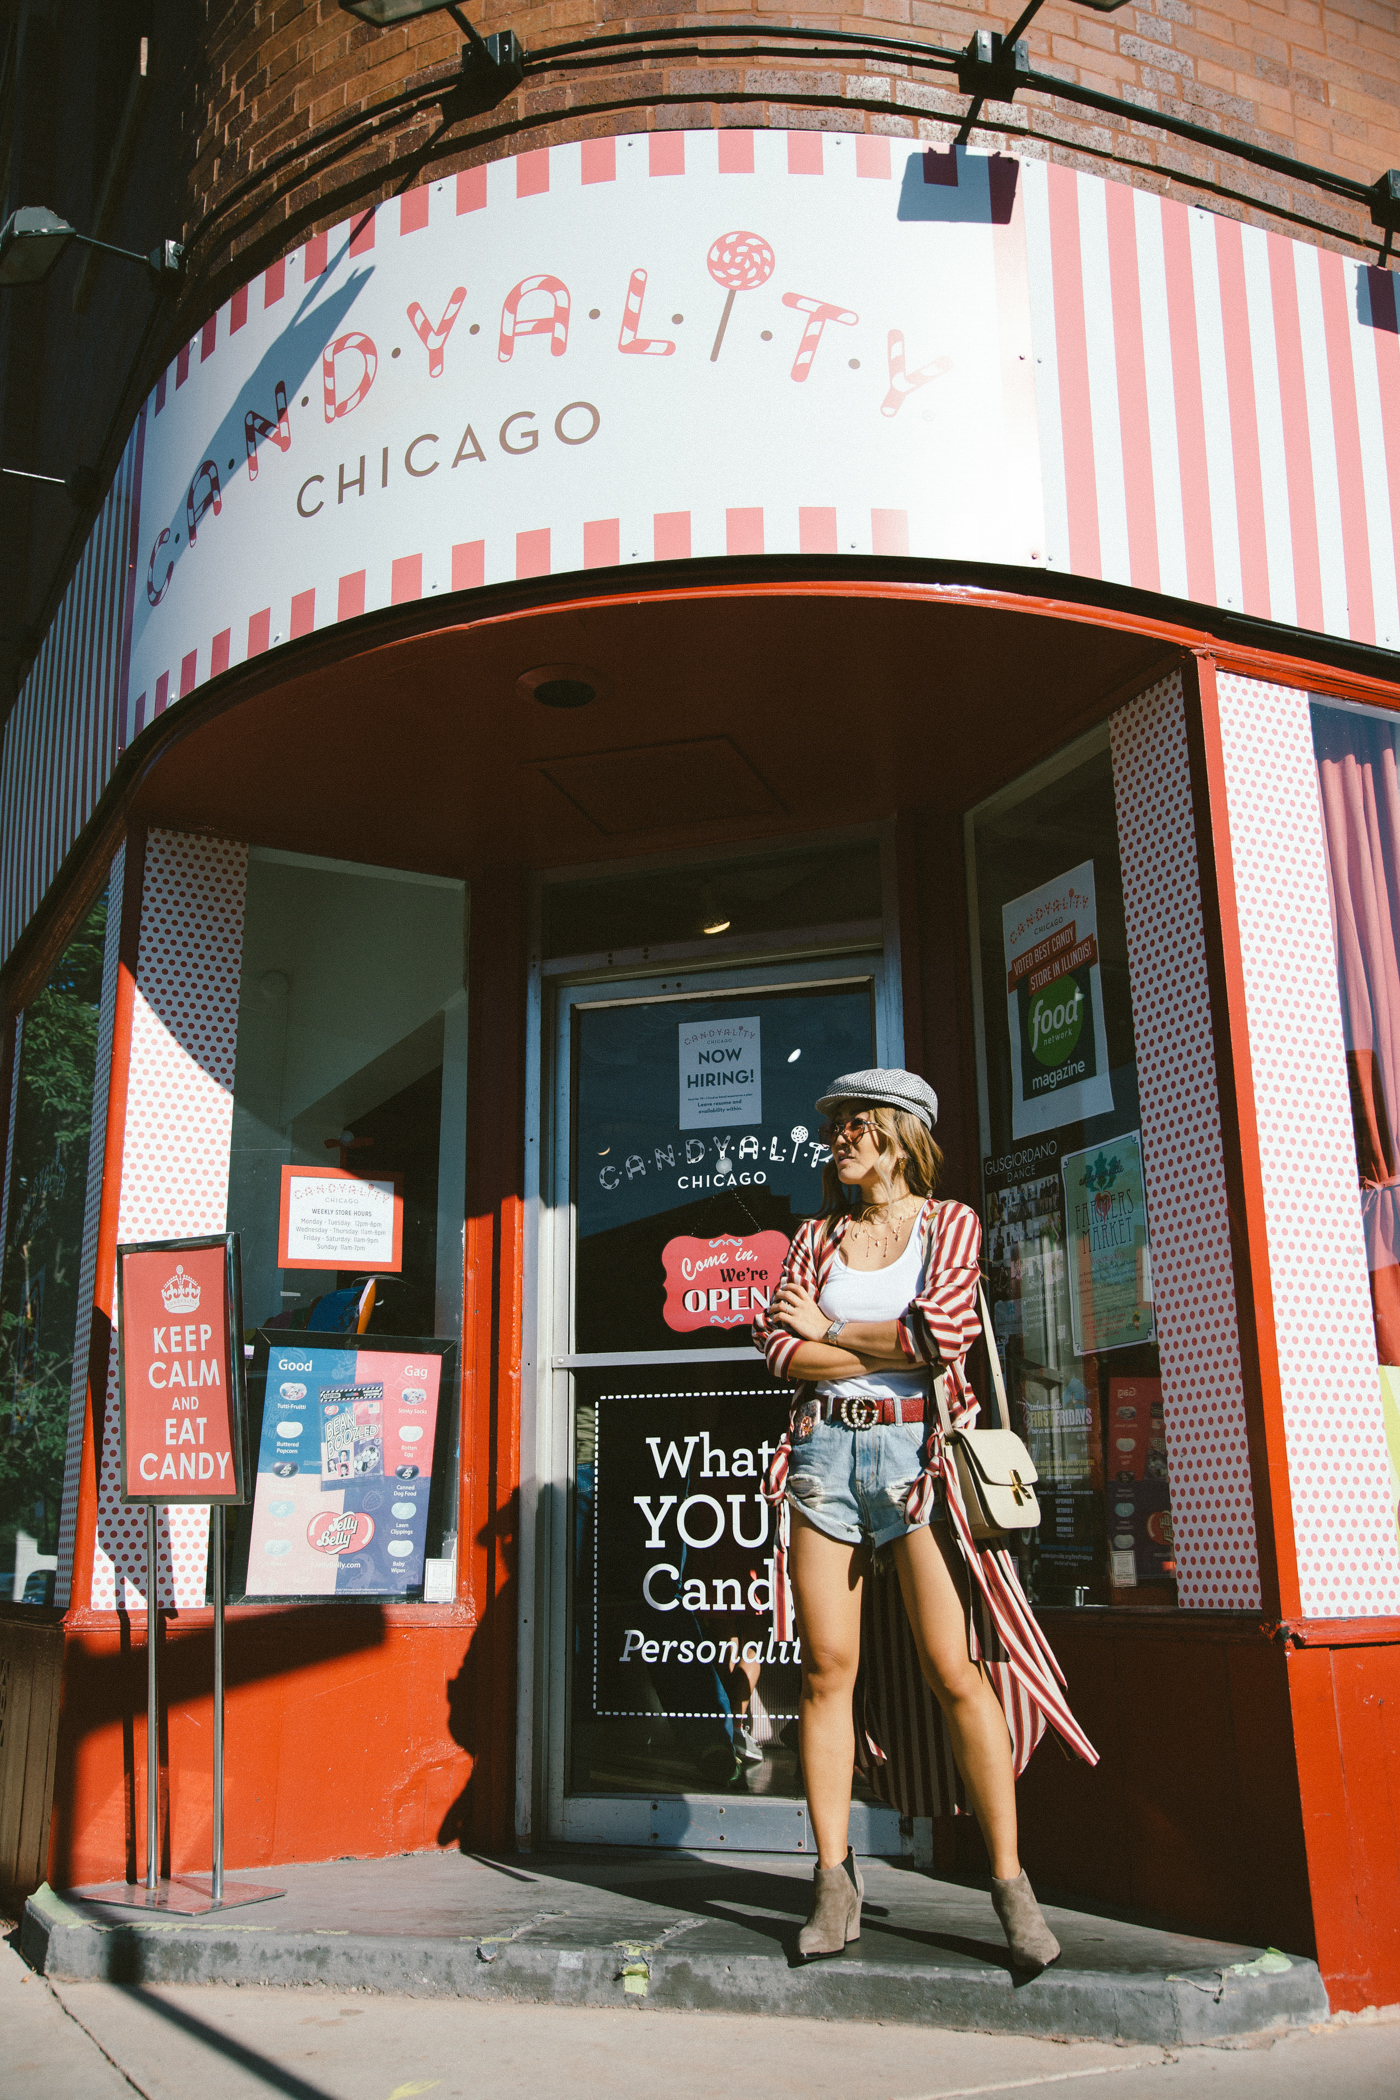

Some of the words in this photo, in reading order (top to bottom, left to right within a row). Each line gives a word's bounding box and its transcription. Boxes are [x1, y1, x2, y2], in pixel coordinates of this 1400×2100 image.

[297, 401, 600, 517] CHICAGO
[1034, 916, 1064, 935] CHICAGO
[1013, 958, 1034, 976] VOTED
[1034, 944, 1051, 964] BEST
[1051, 925, 1074, 952] CANDY
[1030, 970, 1052, 991] STORE
[1052, 965, 1060, 978] IN
[1061, 940, 1092, 974] ILLINOIS!
[1031, 986, 1081, 1053] food
[1043, 1027, 1073, 1046] network
[699, 1047, 742, 1065] NOW
[687, 1069, 755, 1089] HIRING!
[1032, 1060, 1086, 1090] magazine
[599, 1125, 830, 1190] CANDYALIT
[677, 1171, 767, 1190] CHICAGO
[1007, 1164, 1036, 1183] DANCE
[312, 1208, 334, 1216] WEEKLY
[325, 1197, 359, 1205] CHICAGO
[1074, 1188, 1135, 1230] FARMERS
[296, 1226, 328, 1235] Wednesday
[360, 1228, 387, 1237] 11am-8pm
[301, 1218, 323, 1226] Monday
[354, 1220, 382, 1228] 12pm-8pm
[1081, 1217, 1133, 1255] MARKET
[303, 1235, 321, 1243] Friday
[681, 1249, 729, 1281] Come
[735, 1247, 759, 1262] in,
[719, 1268, 768, 1283] We're
[683, 1285, 770, 1313] OPEN
[153, 1324, 212, 1354] KEEP
[148, 1358, 221, 1389] CALM
[278, 1358, 313, 1372] Good
[404, 1365, 428, 1380] Gag
[171, 1396, 199, 1411] AND
[398, 1407, 413, 1415] Stinky
[1053, 1407, 1093, 1426] FRIDAYS
[165, 1417, 207, 1446] EAT
[324, 1407, 357, 1443] BEAN
[327, 1424, 378, 1459] BOOZLED
[645, 1431, 776, 1479] What
[139, 1451, 230, 1481] CANDY
[328, 1513, 358, 1535] Jelly
[390, 1528, 414, 1536] Clippings
[633, 1493, 791, 1549] YOU
[316, 1530, 351, 1549] Belly
[642, 1558, 796, 1620] Cand
[618, 1627, 802, 1664] Personalit
